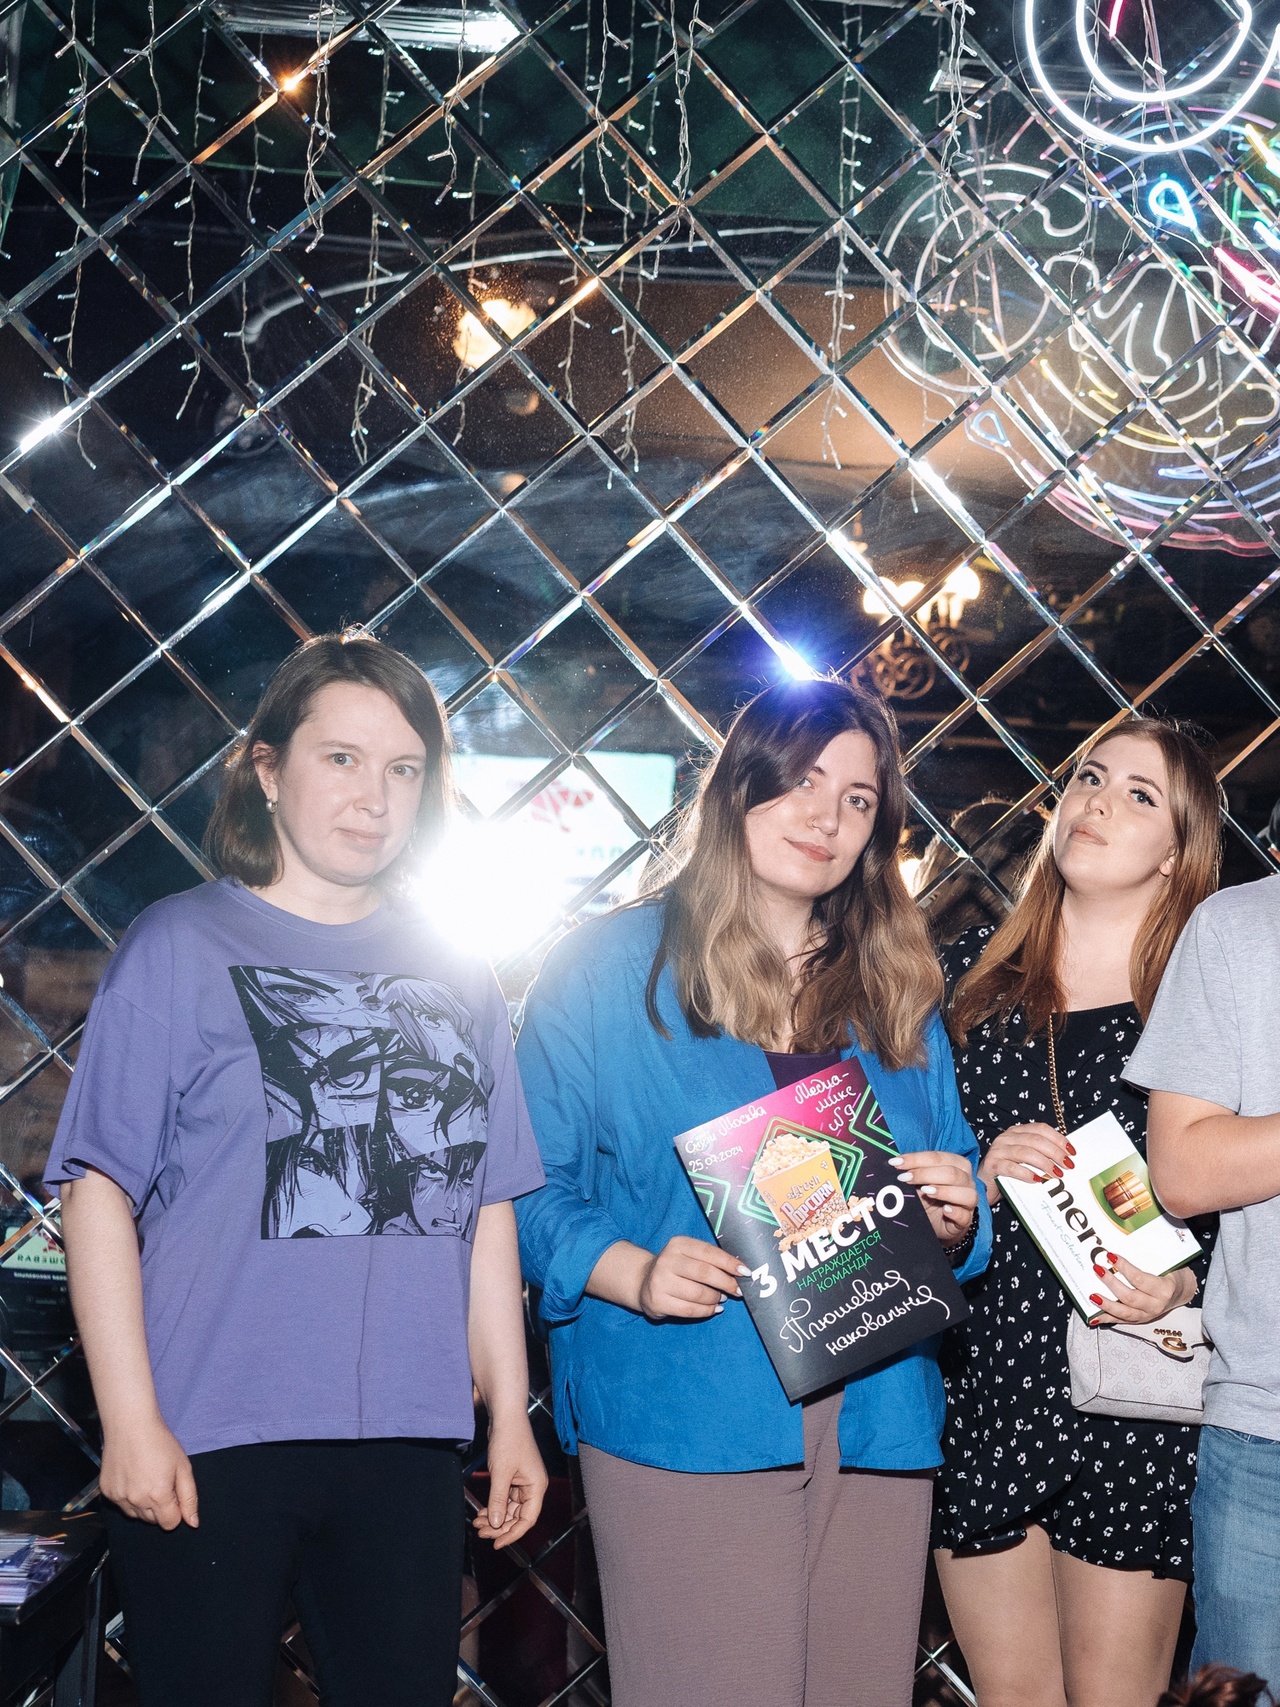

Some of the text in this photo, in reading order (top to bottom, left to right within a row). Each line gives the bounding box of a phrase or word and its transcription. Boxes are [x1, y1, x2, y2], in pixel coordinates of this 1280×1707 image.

[719, 1105, 767, 1137] Москва
[689, 1145, 744, 1173] 25.07.2024
[751, 1185, 905, 1298] 3 МЕСТО
[1040, 1176, 1118, 1275] merc
[796, 1230, 882, 1291] НАГРАЖДАЕТСЯ
[816, 1253, 873, 1293] КОМАНДА
[779, 1270, 911, 1353] Плюшевая
[825, 1285, 950, 1355] наковальня
